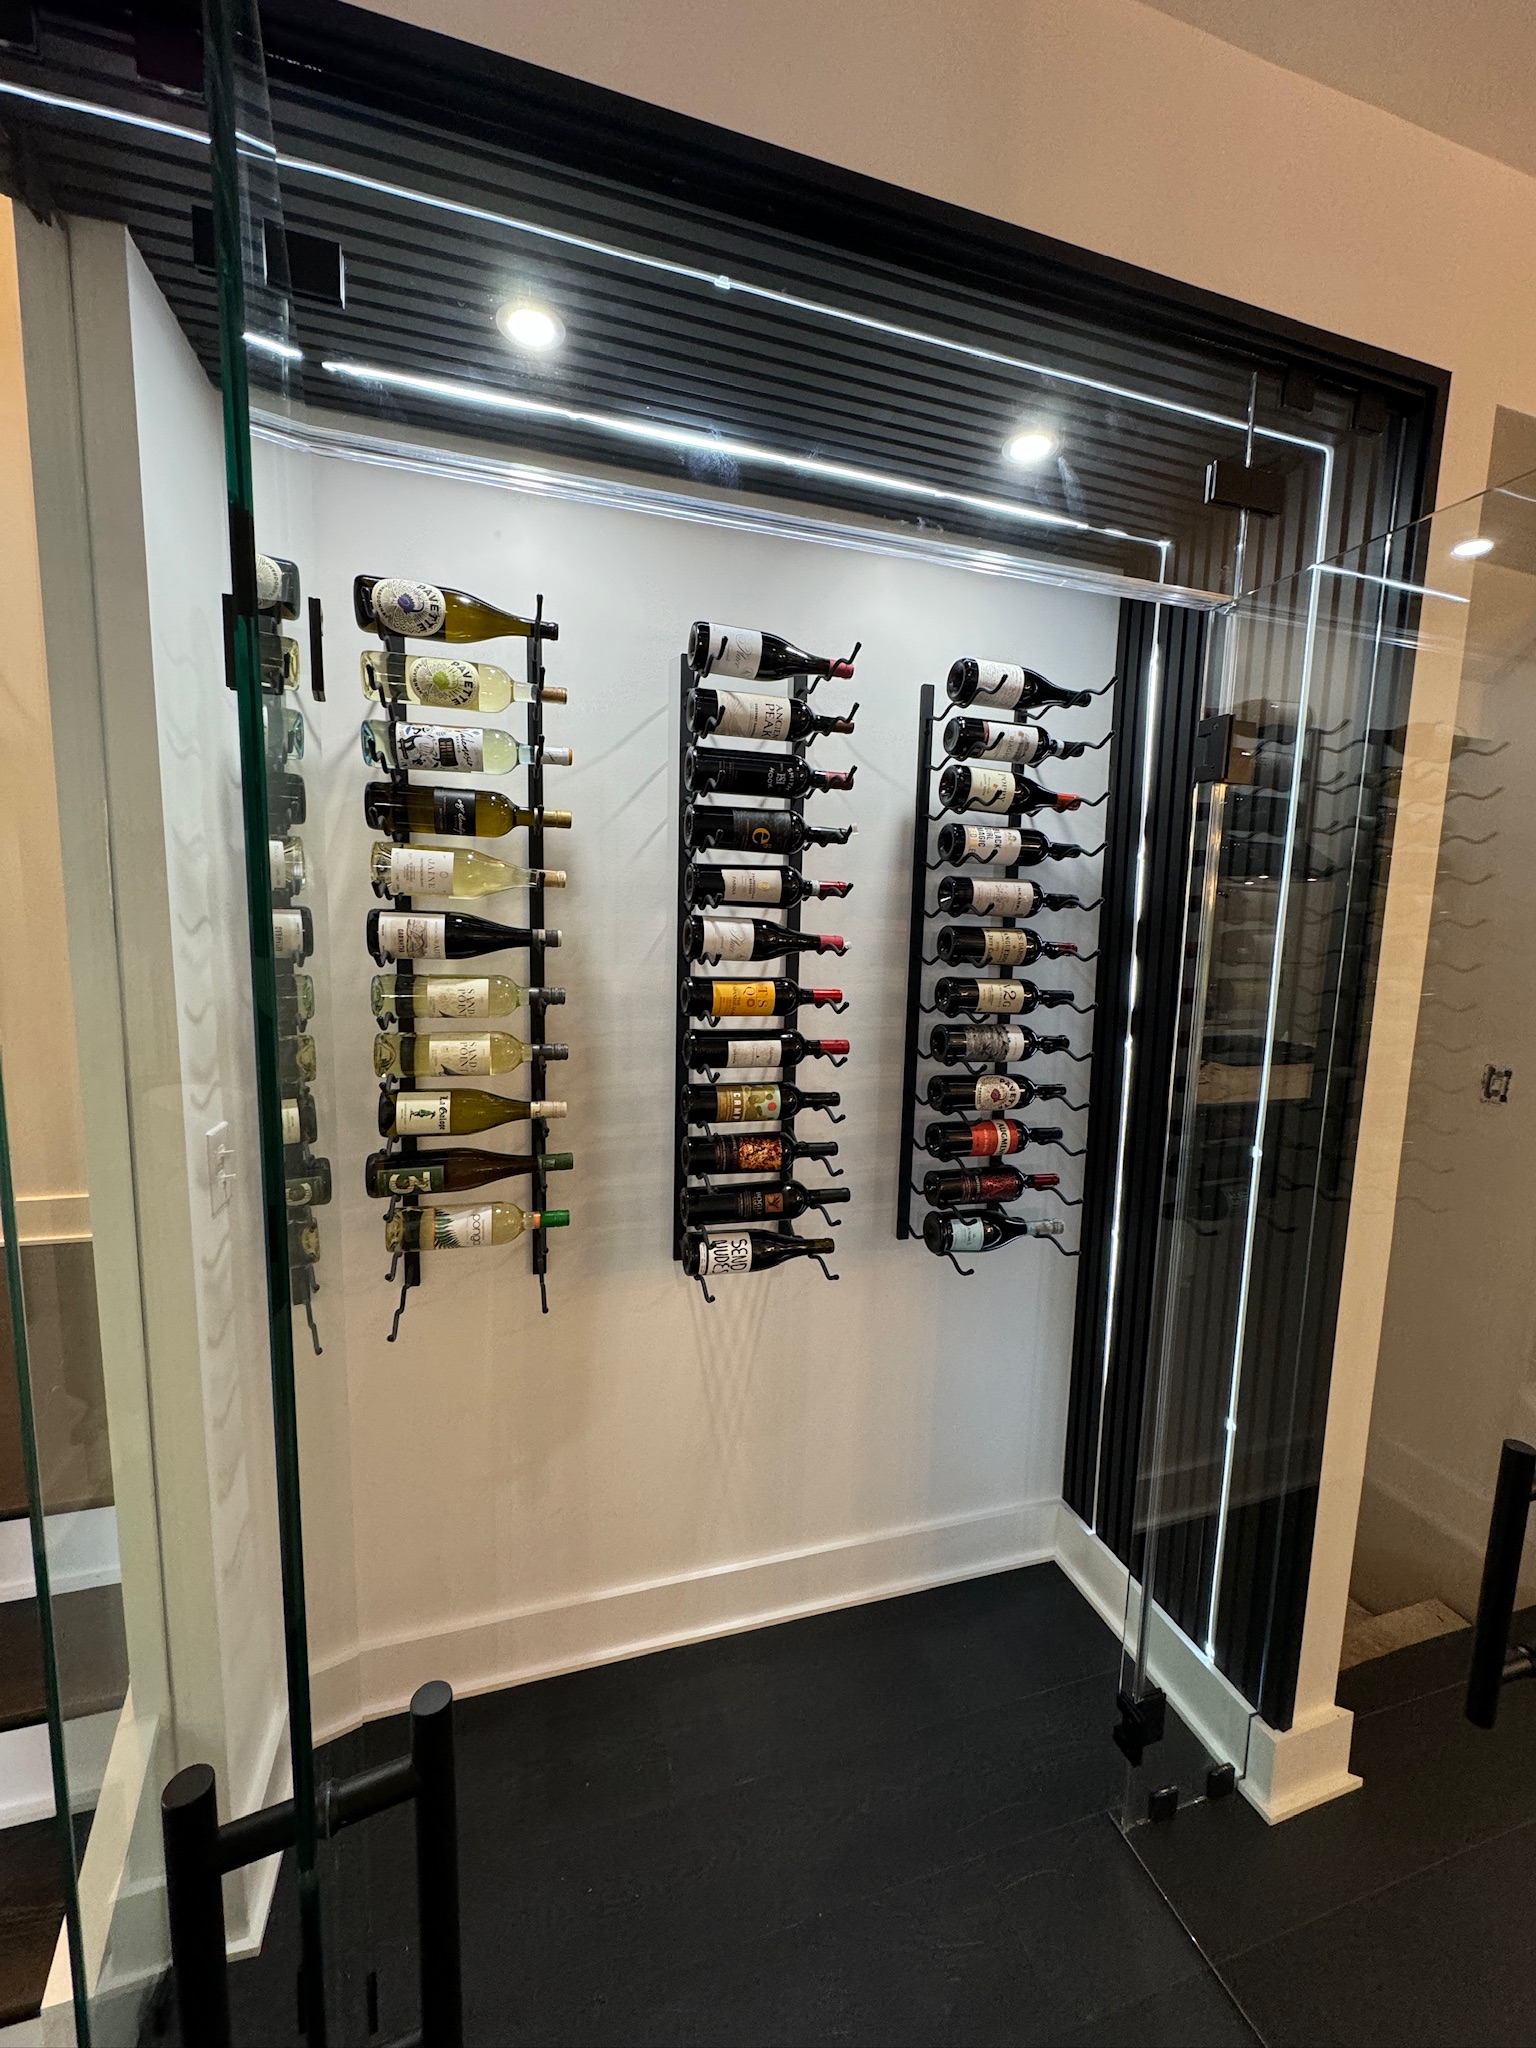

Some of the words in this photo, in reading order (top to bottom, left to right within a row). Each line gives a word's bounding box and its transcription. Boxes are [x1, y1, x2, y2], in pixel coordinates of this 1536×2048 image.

[376, 584, 389, 618] CHARDONNAY
[416, 584, 440, 632] PAVETTE
[412, 663, 424, 695] SAUVIGNON
[451, 661, 474, 706] PAVETTE
[767, 767, 775, 788] HOOK
[786, 767, 795, 791] SMITH
[998, 773, 1008, 803] POPPY
[978, 827, 986, 848] MAGIC
[993, 828, 1002, 848] BLACK
[427, 858, 436, 889] JAINE
[458, 988, 467, 1018] POINT
[467, 988, 475, 1015] SAND
[743, 986, 756, 996] Q
[758, 987, 768, 996] T
[758, 1000, 768, 1008] S
[460, 1041, 468, 1072] POINT
[469, 1041, 477, 1068] SAND
[439, 1095, 448, 1105] La
[733, 1092, 742, 1120] CAMP
[438, 1106, 448, 1131] Galope
[997, 1122, 1008, 1154] AUGMEN
[712, 1239, 730, 1274] NUDES
[730, 1238, 748, 1271] SEND
